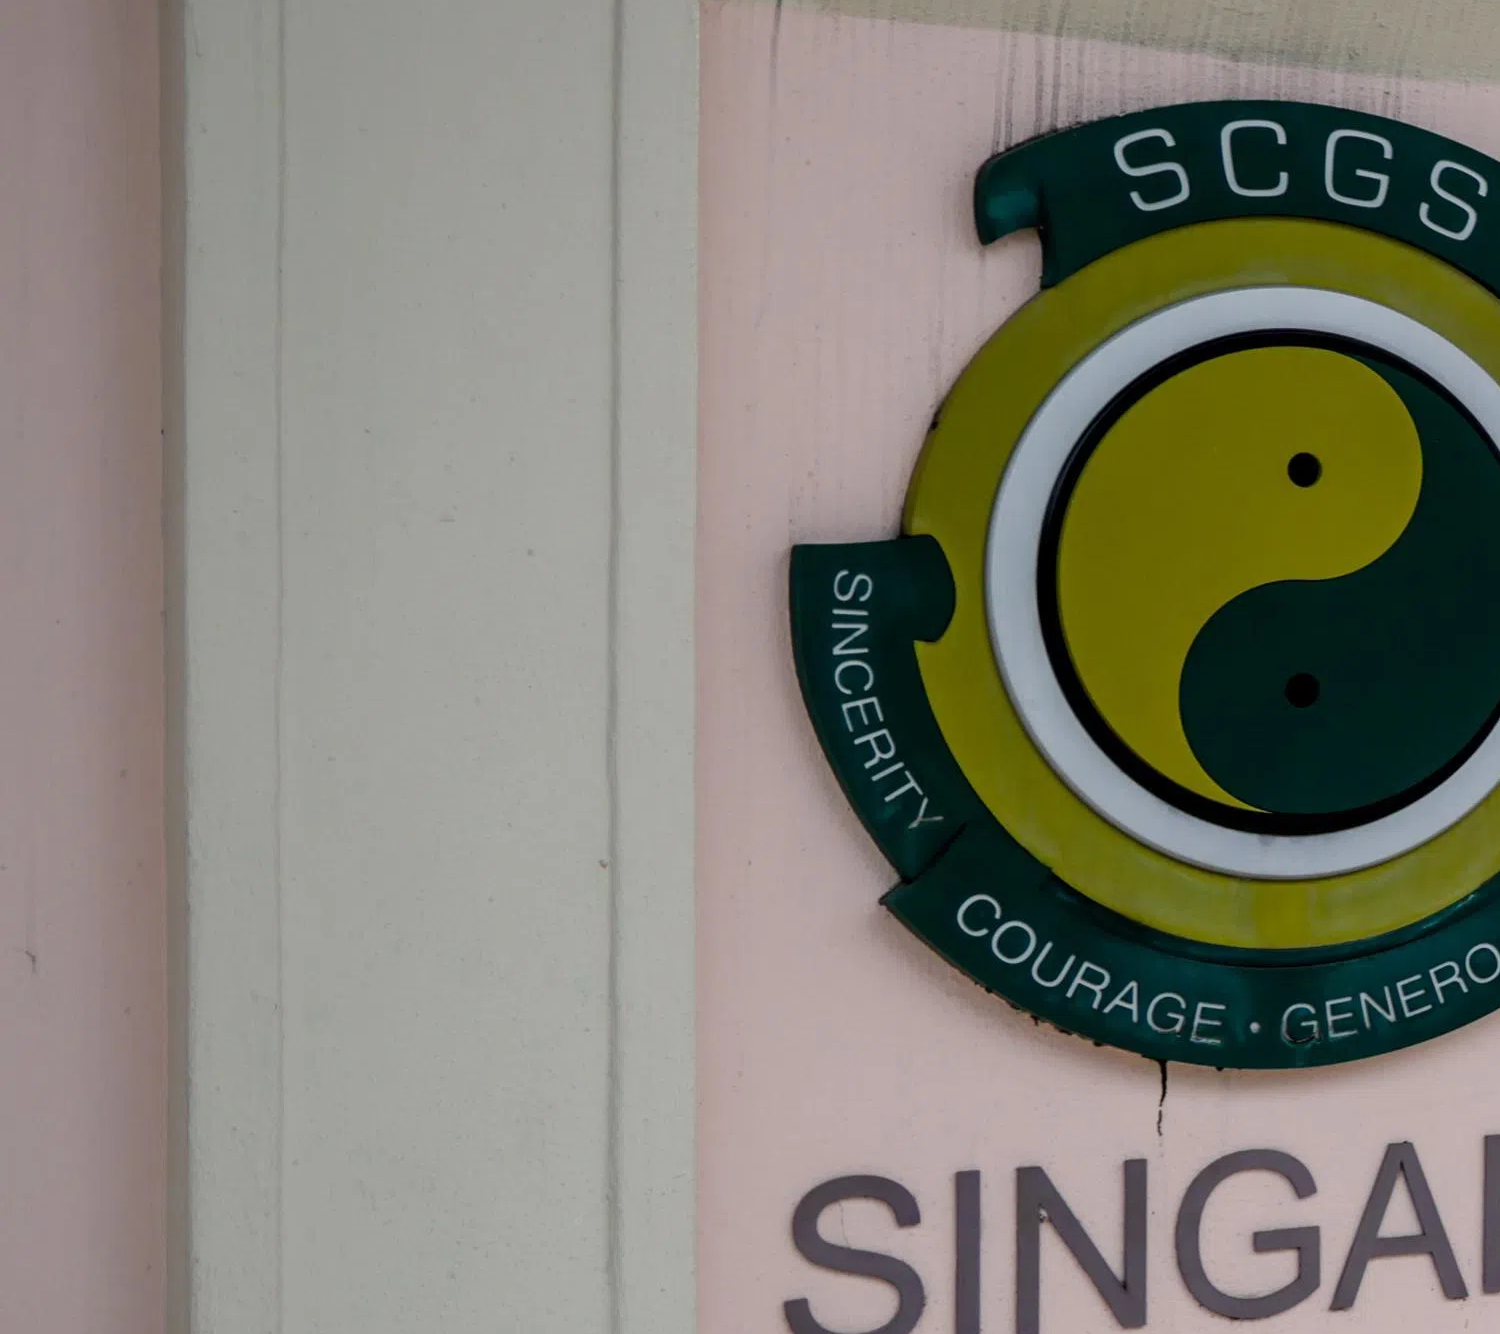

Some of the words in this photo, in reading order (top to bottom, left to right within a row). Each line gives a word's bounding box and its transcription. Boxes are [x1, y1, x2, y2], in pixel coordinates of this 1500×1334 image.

[1112, 118, 1489, 242] SCGS
[830, 568, 945, 830] SINCERITY
[955, 893, 1228, 1047] COURAGE
